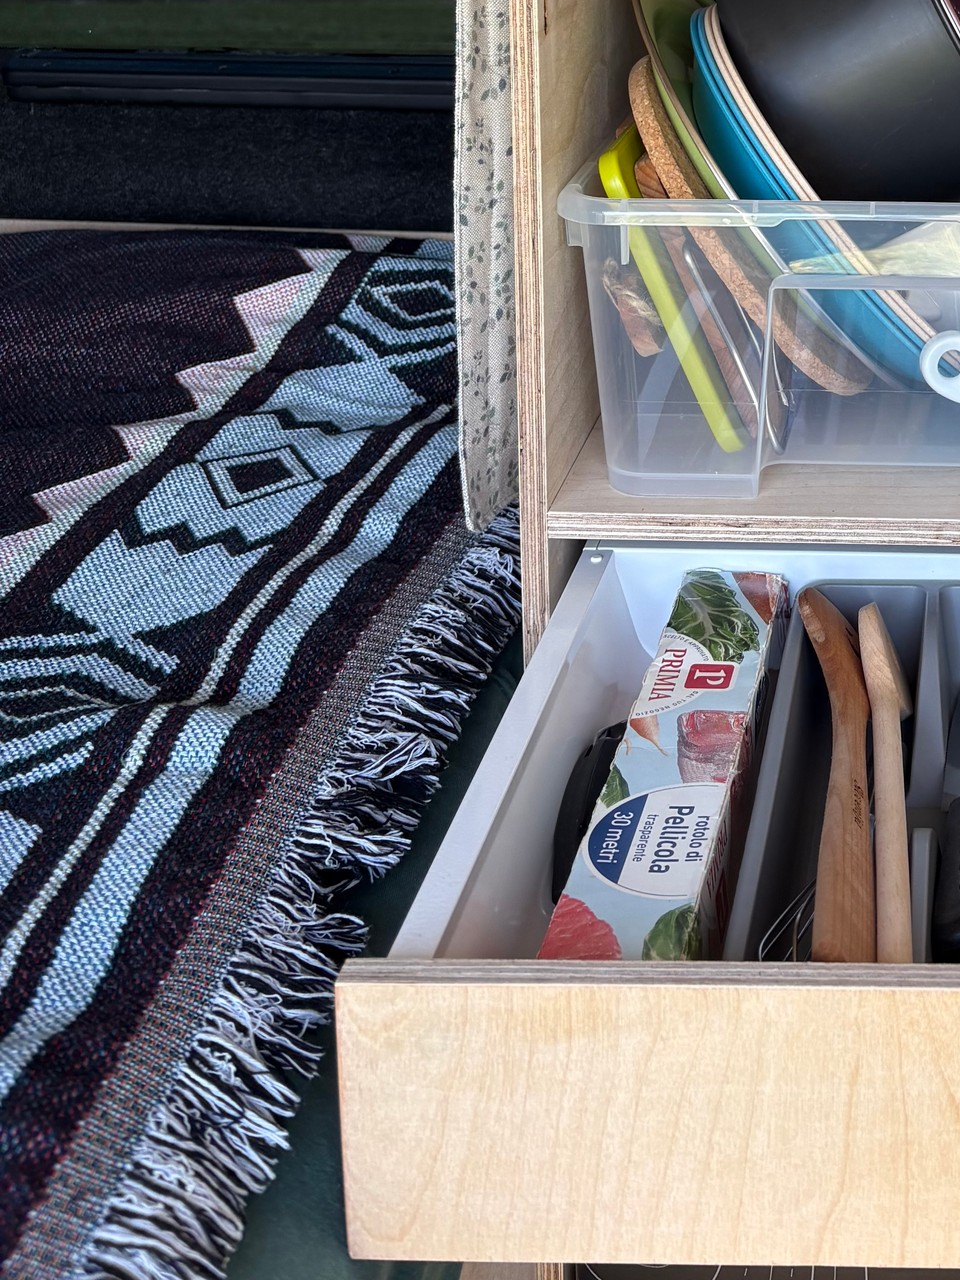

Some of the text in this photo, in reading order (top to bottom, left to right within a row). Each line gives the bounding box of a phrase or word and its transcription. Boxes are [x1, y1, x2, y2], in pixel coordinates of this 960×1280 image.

[648, 648, 688, 702] PRIMIA
[635, 704, 671, 717] NEGOZIO
[596, 811, 634, 864] 30 metri
[632, 814, 660, 863] trasparente
[648, 805, 696, 874] Pellicola
[684, 815, 711, 862] rotolo di
